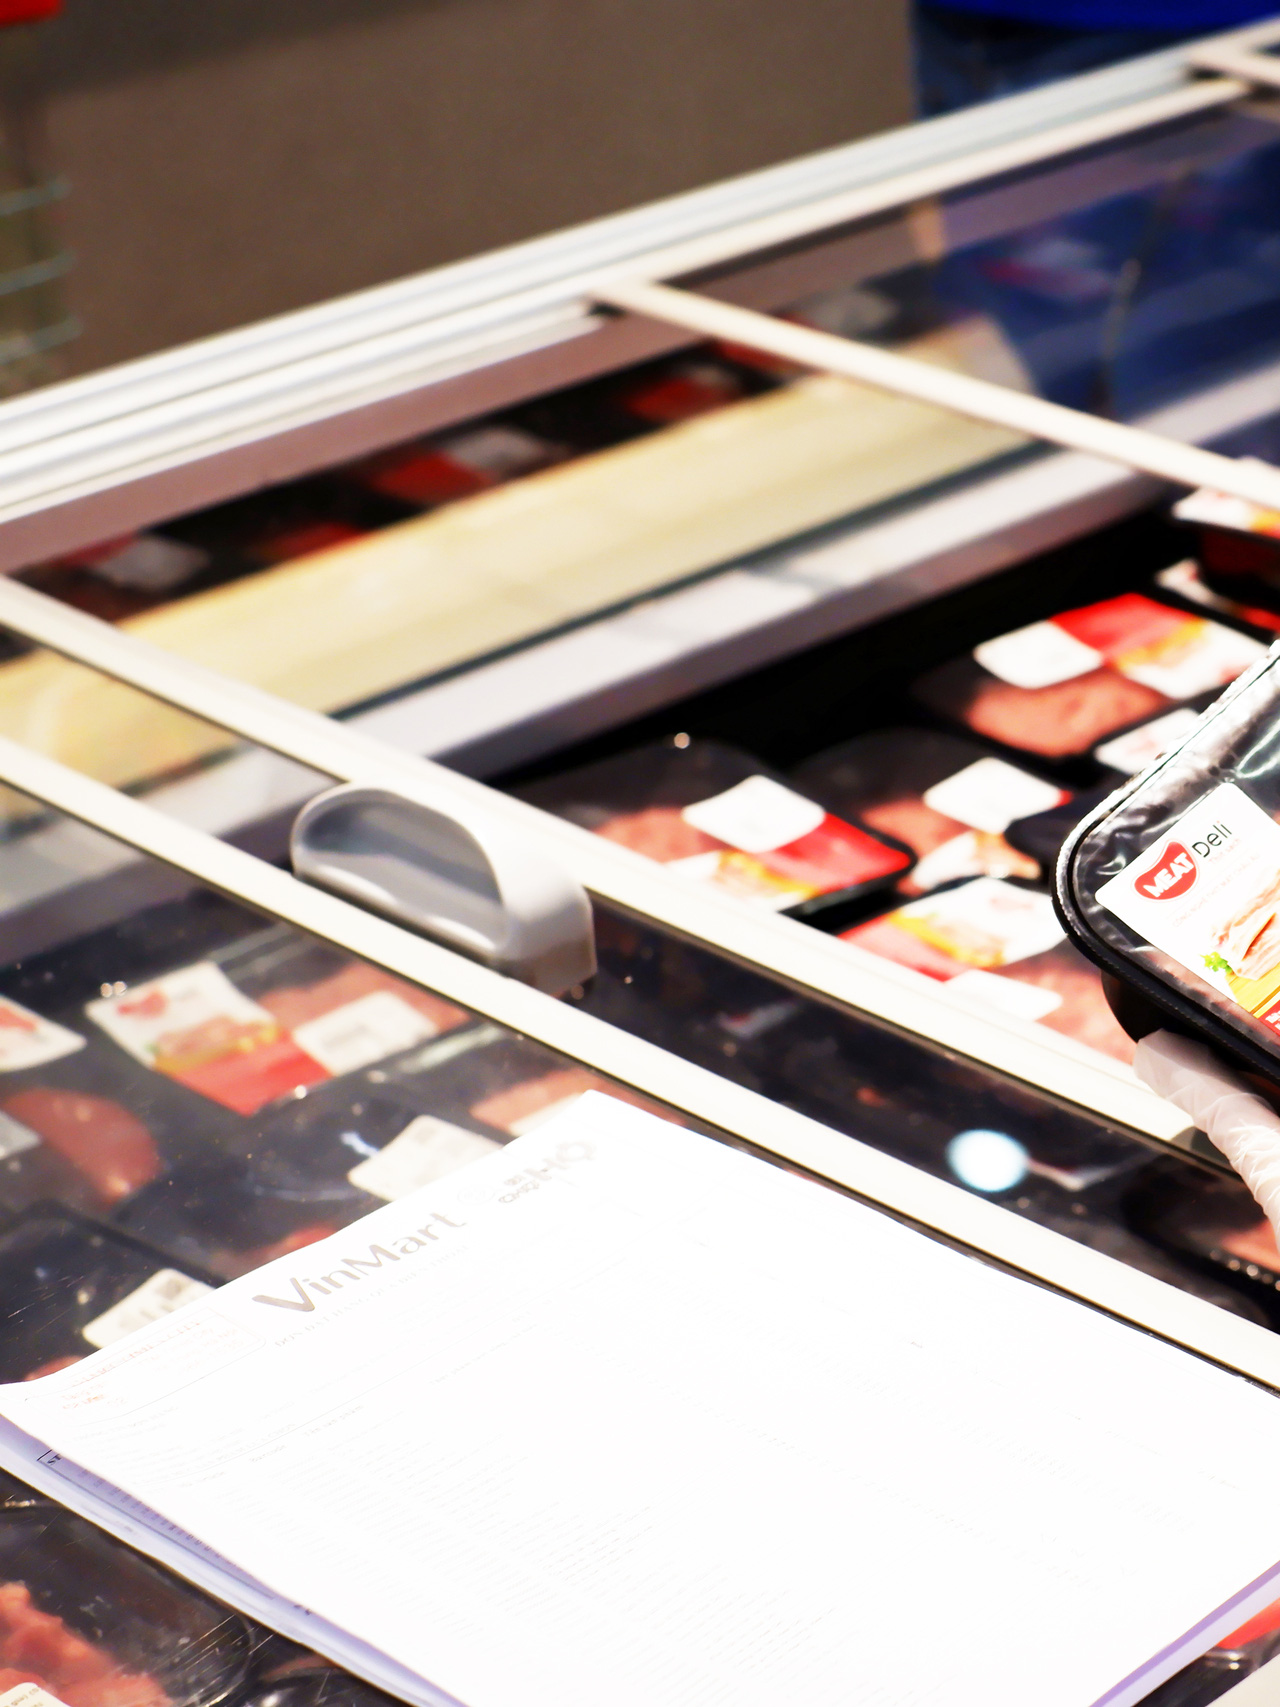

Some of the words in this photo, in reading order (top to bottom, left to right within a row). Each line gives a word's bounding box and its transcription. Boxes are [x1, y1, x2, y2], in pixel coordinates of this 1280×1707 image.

[1142, 851, 1195, 898] MEAT
[1191, 820, 1232, 859] Deli
[251, 1212, 468, 1313] VinMart
